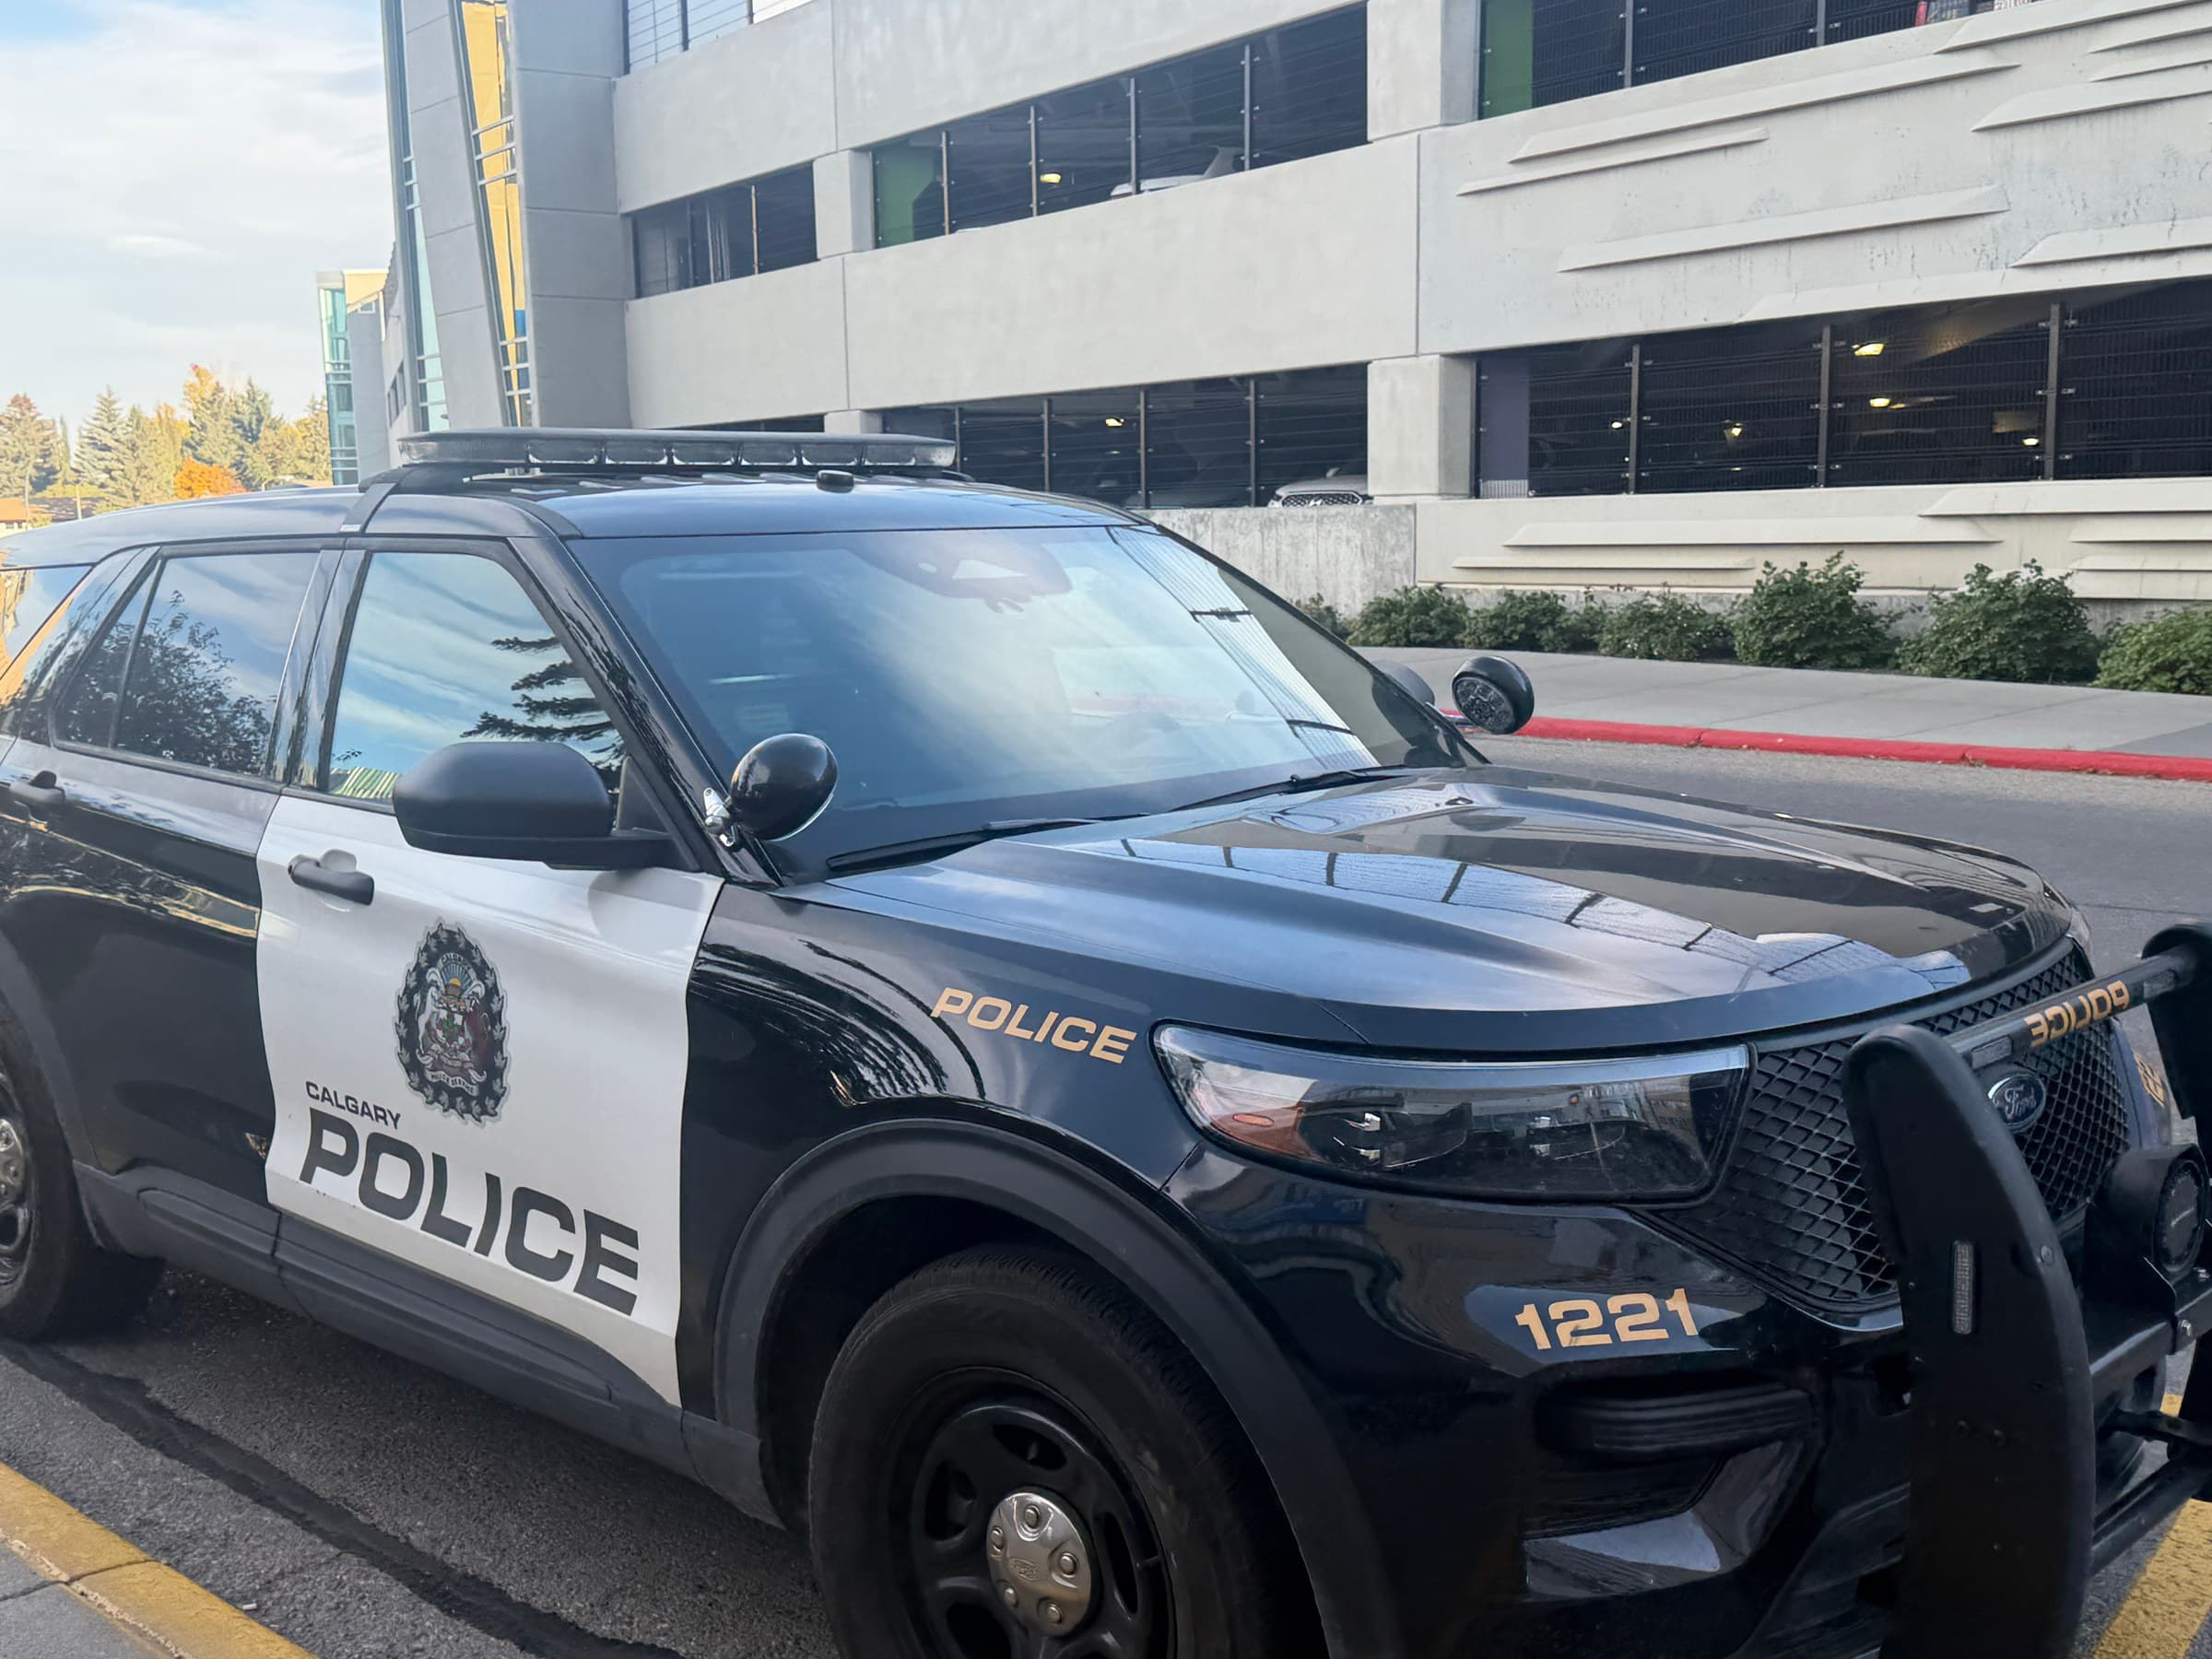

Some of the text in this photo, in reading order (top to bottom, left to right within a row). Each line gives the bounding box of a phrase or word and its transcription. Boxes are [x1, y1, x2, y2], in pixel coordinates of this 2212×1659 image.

[931, 987, 1137, 1064] POLICE
[305, 1081, 402, 1130] CALGARY
[2005, 1085, 2037, 1121] Ford
[299, 1107, 640, 1316] POLICE
[1514, 1288, 1699, 1350] 1221
